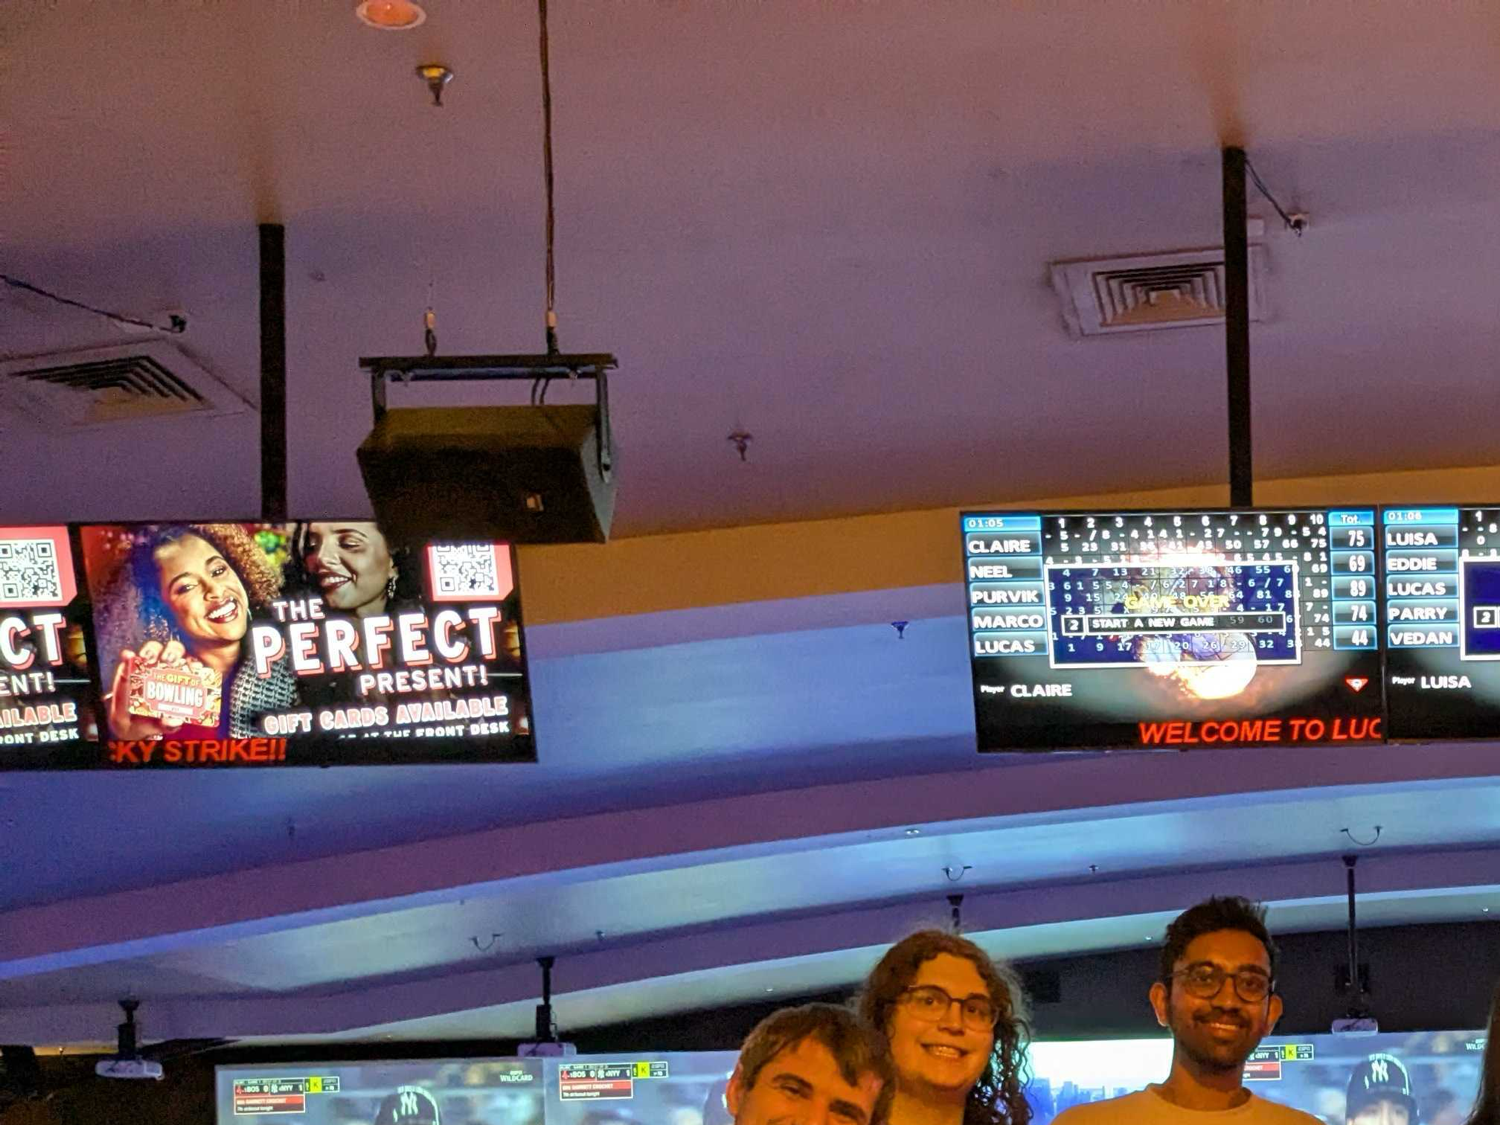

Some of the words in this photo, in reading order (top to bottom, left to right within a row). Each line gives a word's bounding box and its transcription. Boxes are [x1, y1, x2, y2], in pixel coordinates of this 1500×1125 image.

[968, 518, 1004, 528] 01:05
[1309, 514, 1324, 525] 10
[968, 539, 1031, 553] CLAIRE
[1348, 530, 1365, 547] 75
[1225, 540, 1242, 549] 50
[1254, 539, 1270, 549] 57
[1311, 538, 1327, 548] 75
[1387, 532, 1438, 546] LUISA
[970, 564, 1013, 578] NEEL
[1312, 563, 1328, 573] 69
[1349, 554, 1366, 572] 69
[1387, 557, 1437, 571] EDDIE
[972, 589, 1039, 604] PURVIK
[1313, 588, 1328, 598] 89
[1350, 579, 1366, 597] 89
[1388, 582, 1446, 596] LUCAS
[1125, 594, 1179, 610] GAME
[1183, 593, 1231, 609] OVER
[273, 598, 326, 623] THE
[973, 615, 1044, 629] MARCO
[1314, 613, 1330, 623] 74
[1351, 605, 1367, 622] 74
[1389, 607, 1447, 621] PARRY
[1481, 612, 1490, 623] 2
[1069, 620, 1079, 631] 2
[1092, 619, 1128, 629] START
[1134, 618, 1144, 628] A
[1148, 617, 1176, 628] NEW
[1180, 617, 1215, 627] GAME
[251, 606, 502, 679] PERFECT
[975, 640, 1036, 654] LUCAS
[1352, 630, 1368, 646] 44
[1390, 632, 1452, 645] VEDAN
[360, 664, 489, 696] PRESENT!
[1421, 675, 1471, 690] LUISA
[146, 680, 203, 708] BOWLING
[980, 685, 1005, 695] Player
[1010, 683, 1072, 698] CLAIRE
[264, 712, 313, 735] GIFT
[319, 706, 389, 730] CARDS
[396, 695, 509, 725] AVAILABLE
[40, 728, 80, 743] DESK
[471, 721, 509, 735] DESK
[1139, 719, 1282, 745] WELCOME
[1289, 718, 1325, 741] TO
[164, 737, 286, 763] STRIKE!!
